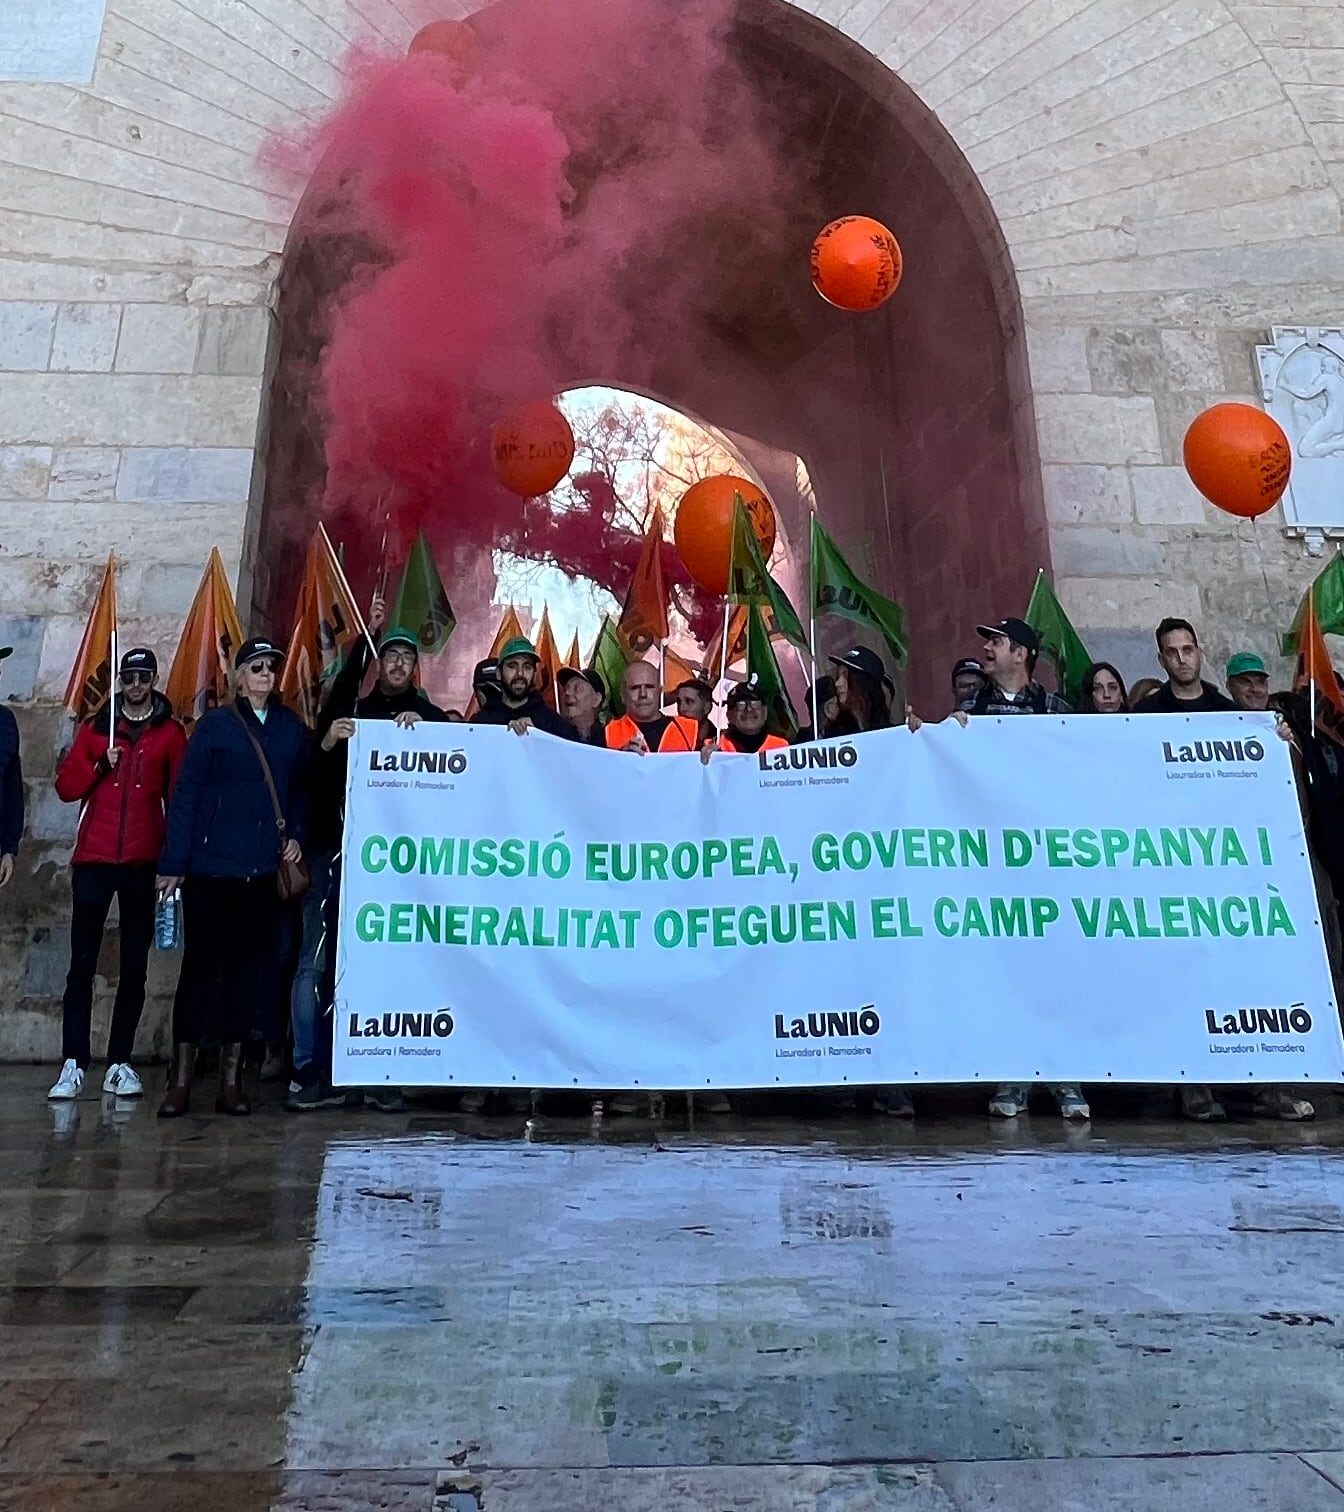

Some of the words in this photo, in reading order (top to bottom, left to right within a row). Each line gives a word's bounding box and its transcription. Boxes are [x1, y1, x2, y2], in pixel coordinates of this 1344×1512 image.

[370, 748, 467, 774] LaUNIÓ
[759, 741, 857, 771] LaUNIÓ
[1162, 735, 1264, 763] LaUNIÓ
[361, 830, 571, 879] COMISSIÓ
[586, 836, 799, 883] EUROPEA,
[812, 829, 989, 872] GOVERN
[1003, 828, 1249, 867] D'ESPANYA
[1258, 827, 1273, 866] I
[356, 902, 641, 949] GENERALITAT
[654, 900, 857, 949] OFEGUEN
[871, 897, 923, 938] EL
[934, 897, 1060, 938] CAMP
[1072, 883, 1297, 938] VALENCIÀ
[349, 1007, 454, 1037] LaUNIÓ
[775, 1004, 880, 1038] LaUNIÓ
[1205, 1003, 1312, 1034] LaUNIÓ
